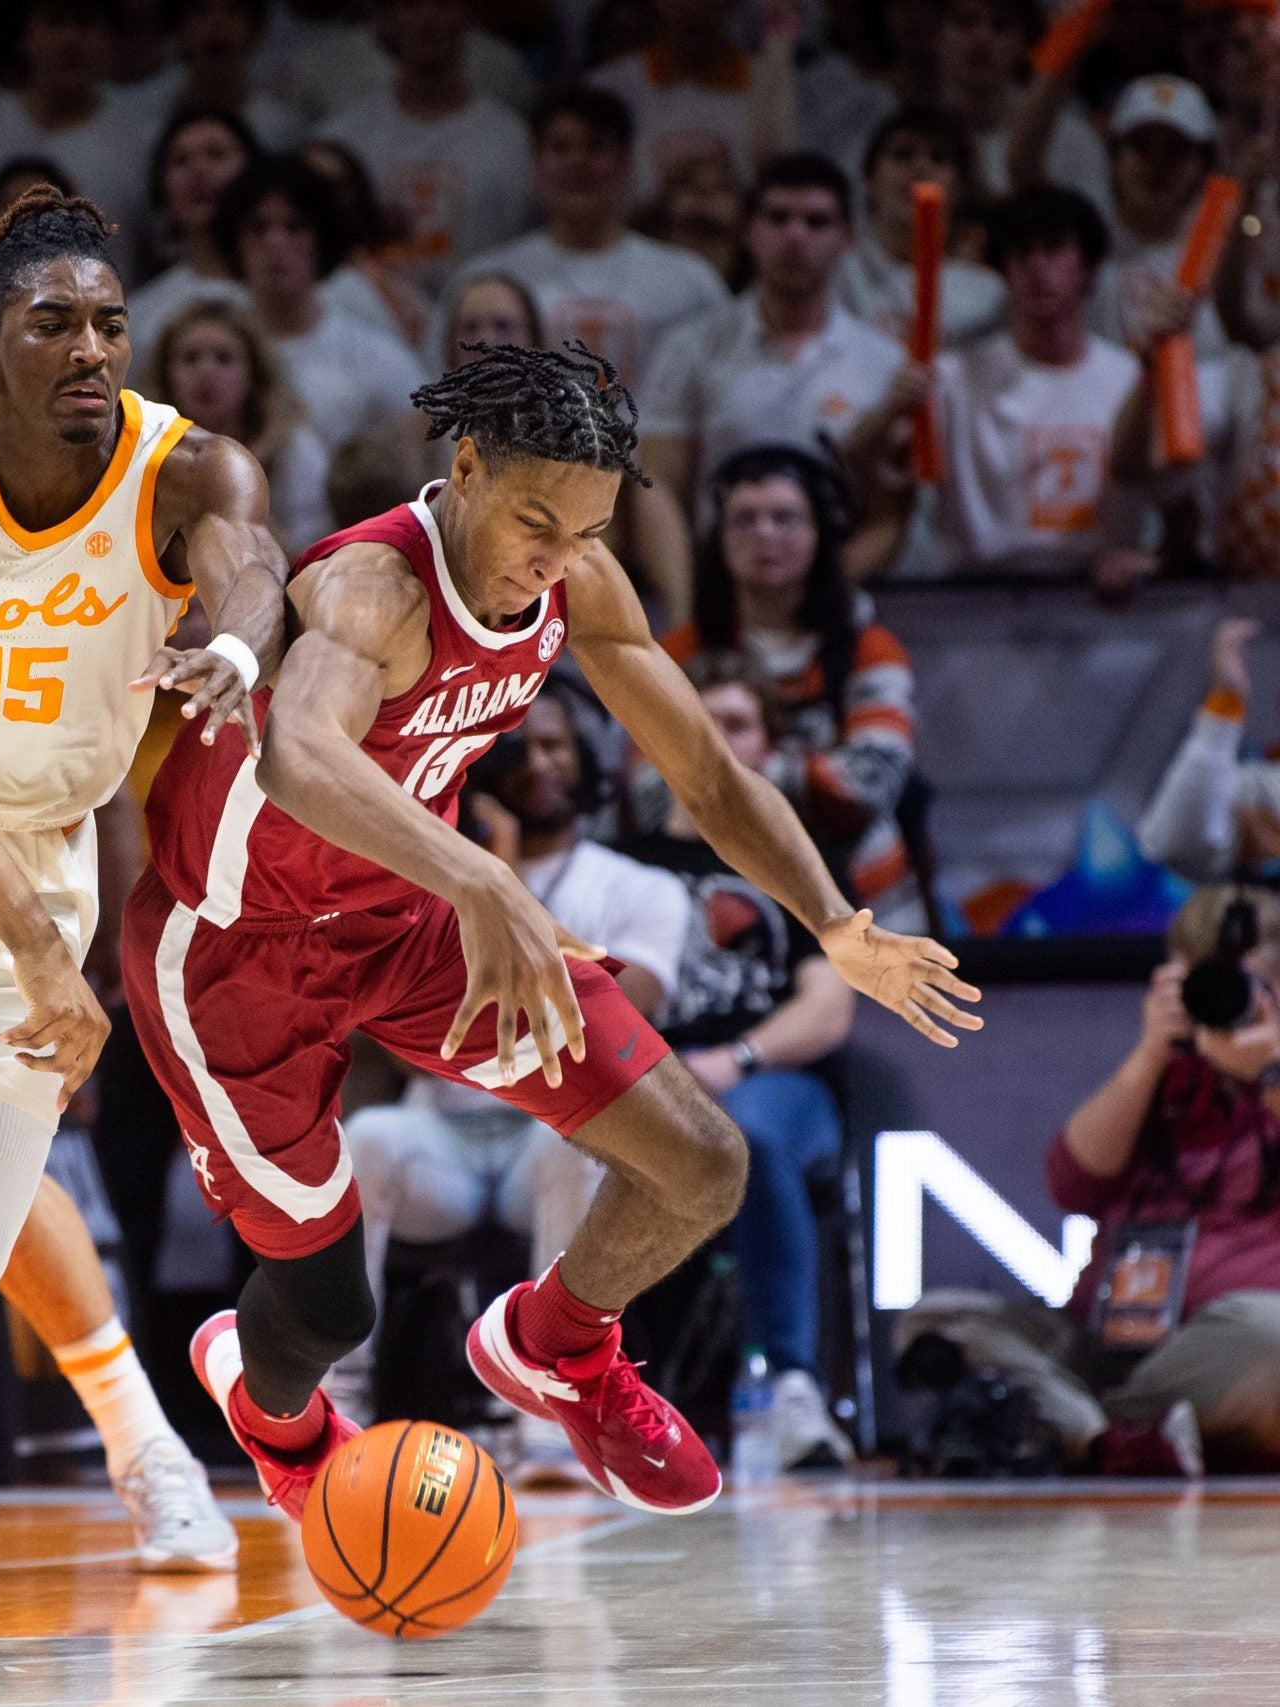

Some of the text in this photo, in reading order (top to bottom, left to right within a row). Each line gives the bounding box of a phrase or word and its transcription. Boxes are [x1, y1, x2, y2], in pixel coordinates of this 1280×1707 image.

[85, 531, 112, 558] SEC
[538, 618, 564, 661] SEC
[401, 732, 500, 800] 15
